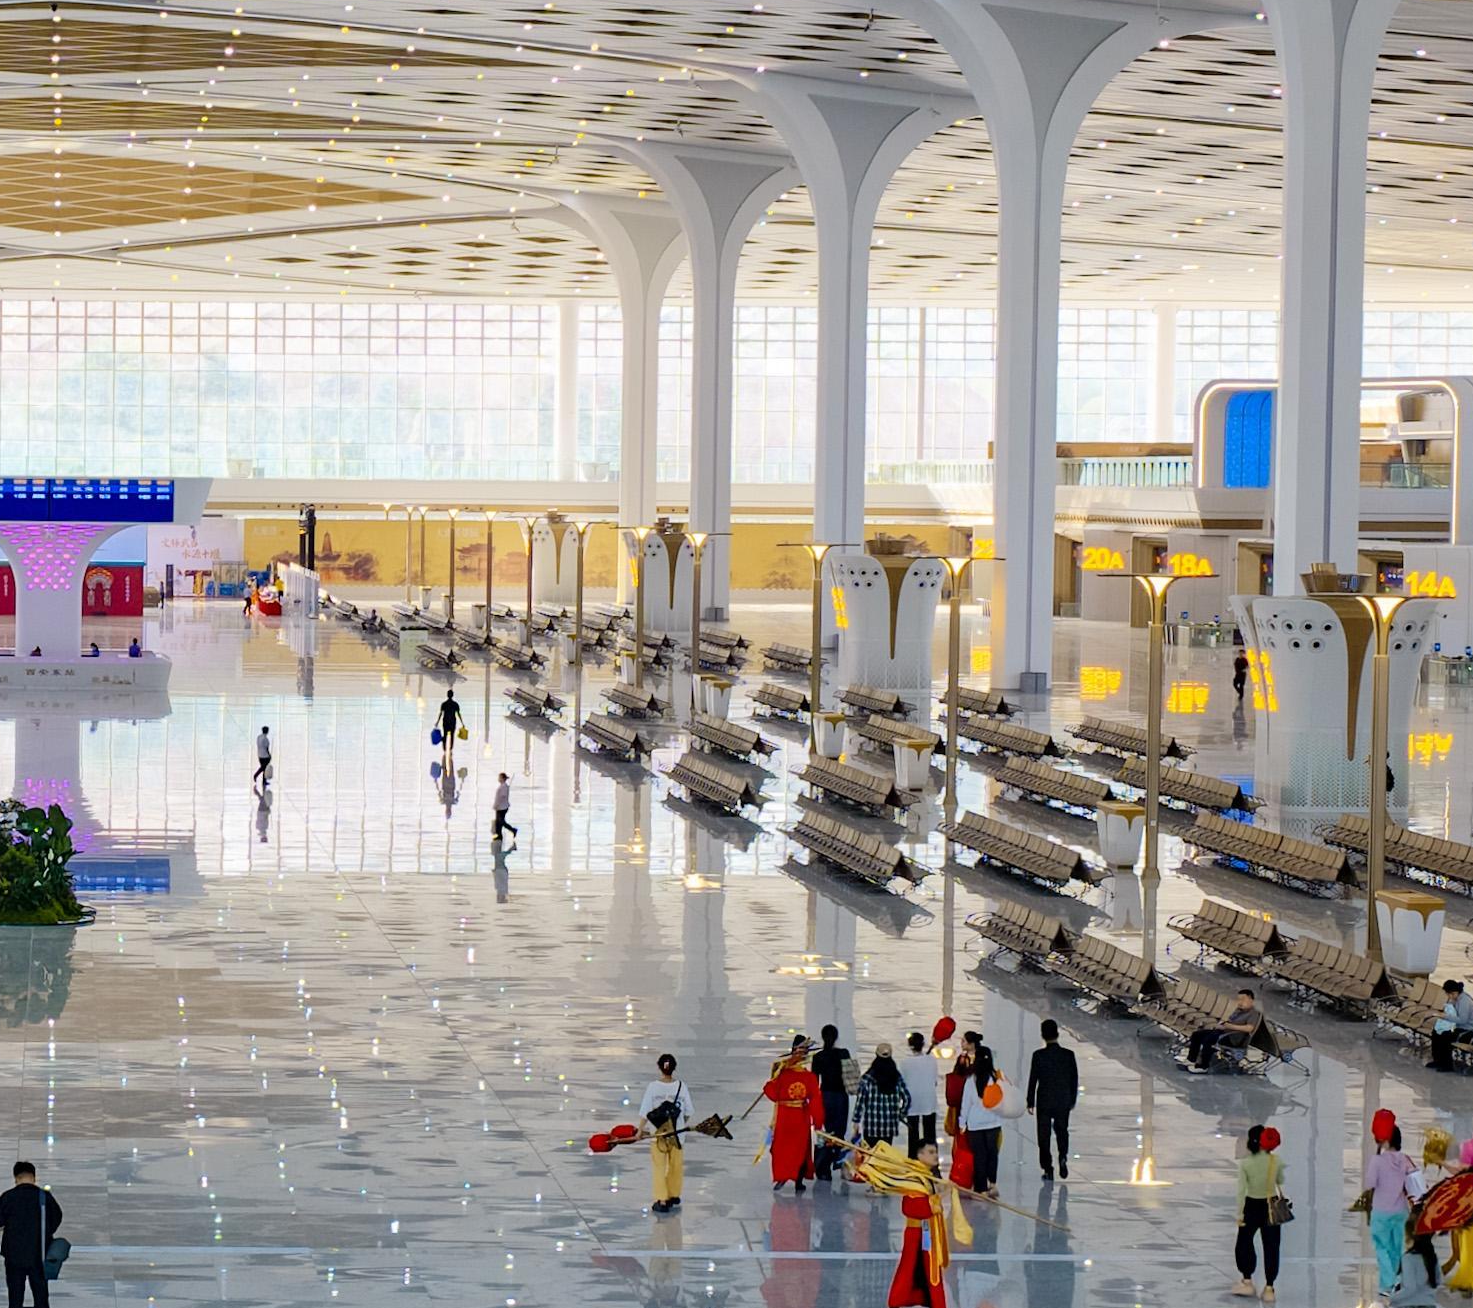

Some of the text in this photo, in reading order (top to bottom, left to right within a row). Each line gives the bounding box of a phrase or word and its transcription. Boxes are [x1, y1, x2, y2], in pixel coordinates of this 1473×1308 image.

[1081, 547, 1125, 570] 20A
[1168, 553, 1214, 576] 18A
[1406, 571, 1456, 597] 14A
